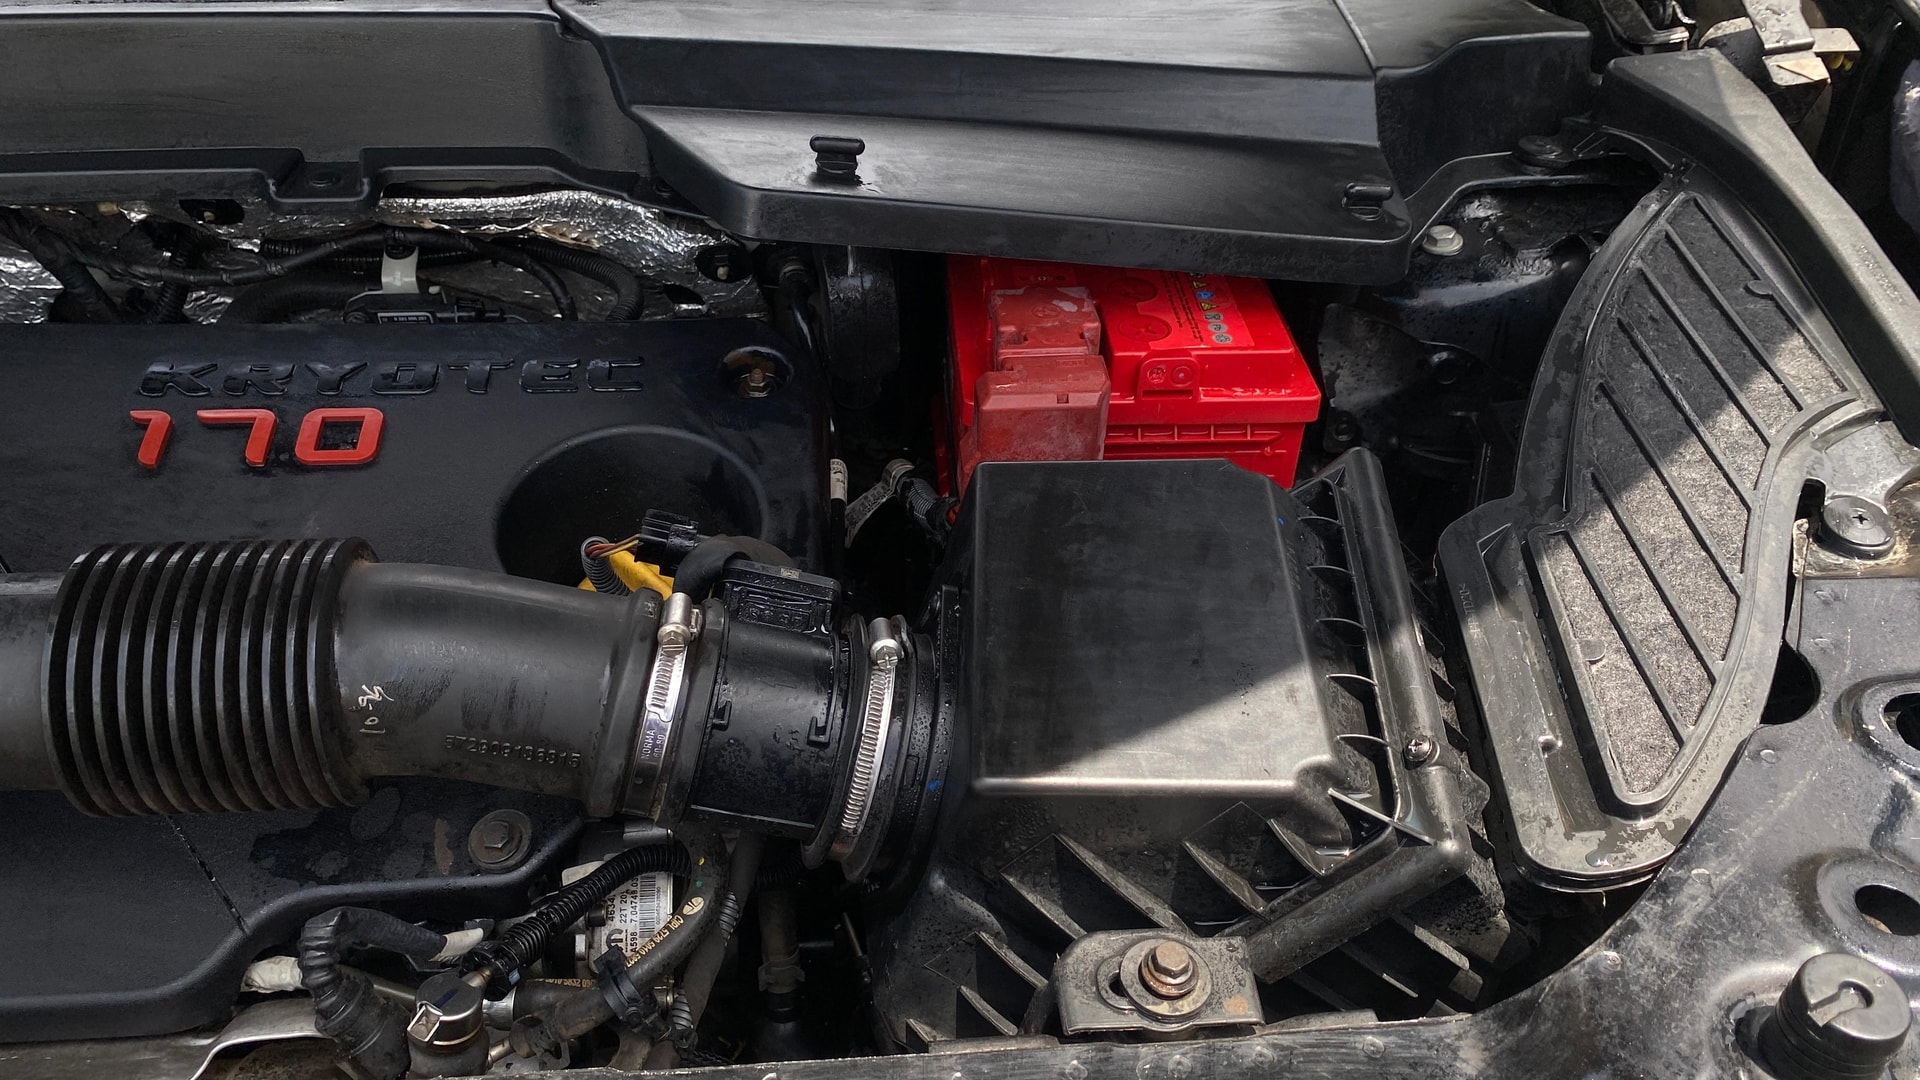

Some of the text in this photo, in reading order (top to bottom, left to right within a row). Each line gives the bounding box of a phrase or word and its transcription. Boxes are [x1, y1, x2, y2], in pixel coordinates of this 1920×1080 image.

[139, 358, 645, 397] KRYOTEC
[129, 407, 384, 469] 170
[640, 728, 656, 760] NORMA
[653, 734, 666, 758] 60-80
[607, 893, 617, 922] 4634
[667, 914, 684, 930] CIPL
[630, 931, 638, 953] A598
